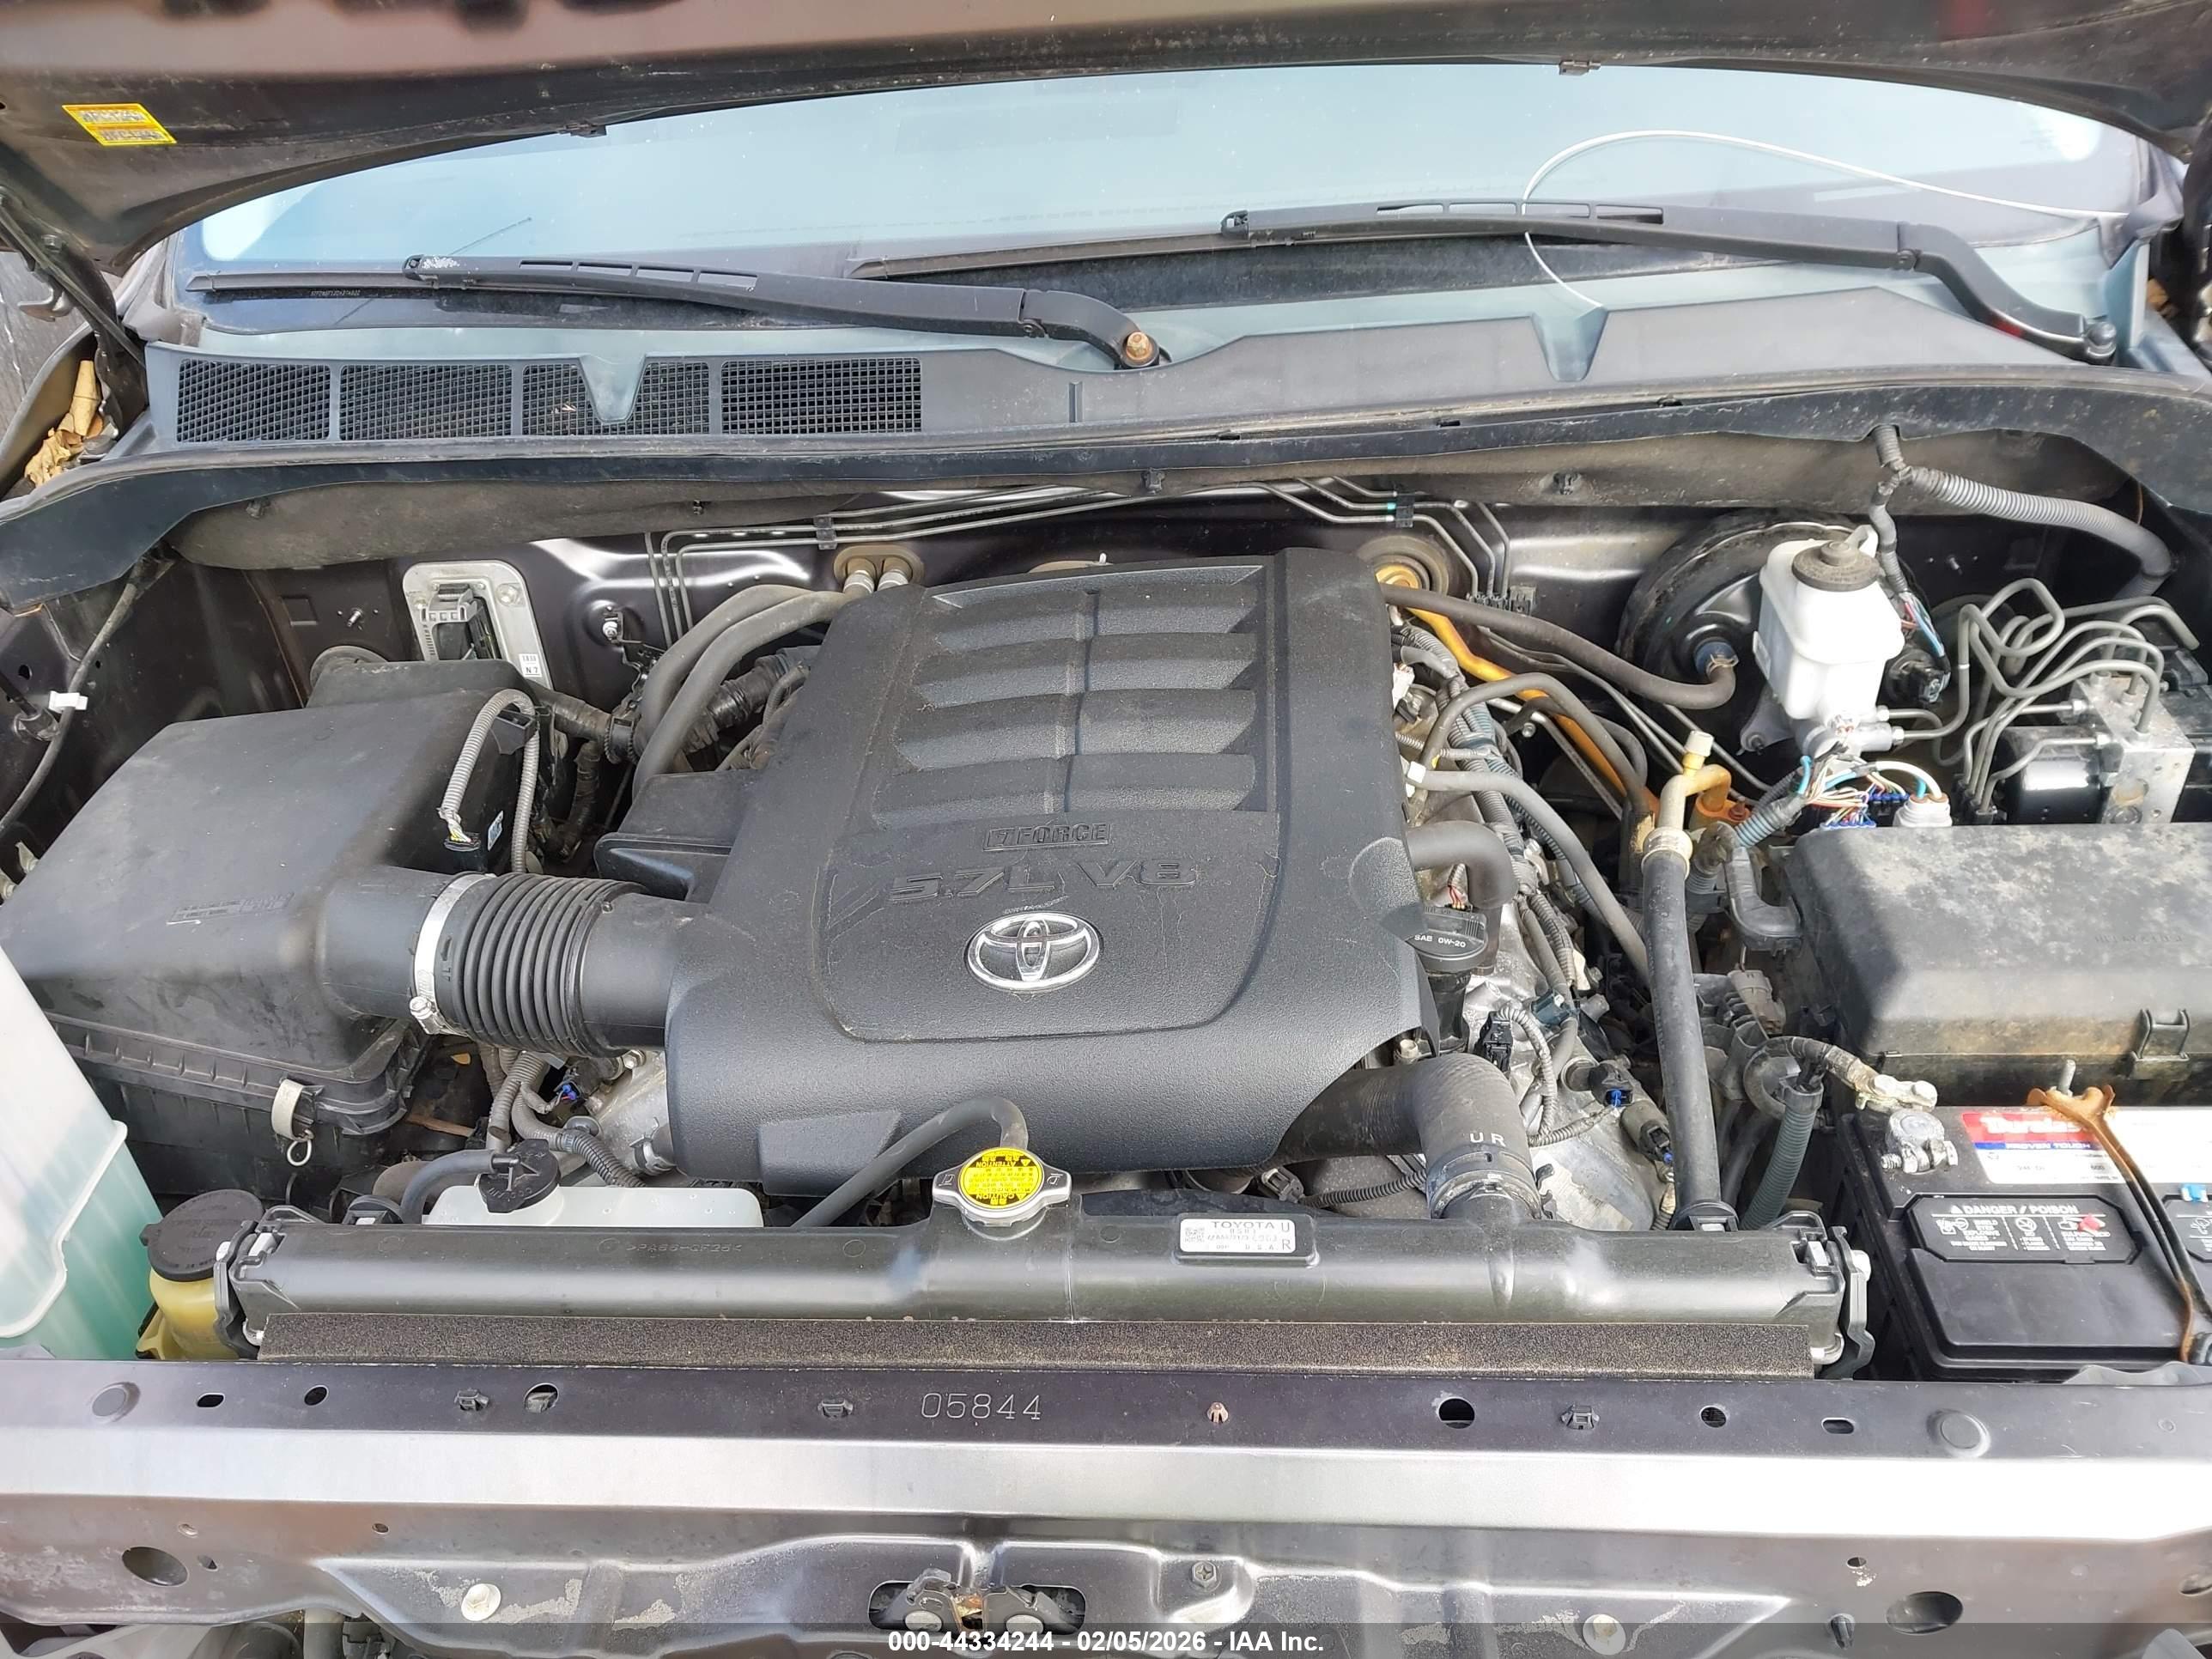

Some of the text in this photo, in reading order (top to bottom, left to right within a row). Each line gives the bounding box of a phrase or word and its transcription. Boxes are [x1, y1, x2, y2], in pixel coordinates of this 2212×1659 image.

[890, 858, 1198, 902] 5.7L V8
[1437, 937, 1467, 948] 0W-20
[1962, 1205, 2019, 1214] DANGER
[2029, 1205, 2080, 1214] POISON
[1212, 1220, 1275, 1229] TOYOTA
[921, 1393, 1042, 1420] 05844
